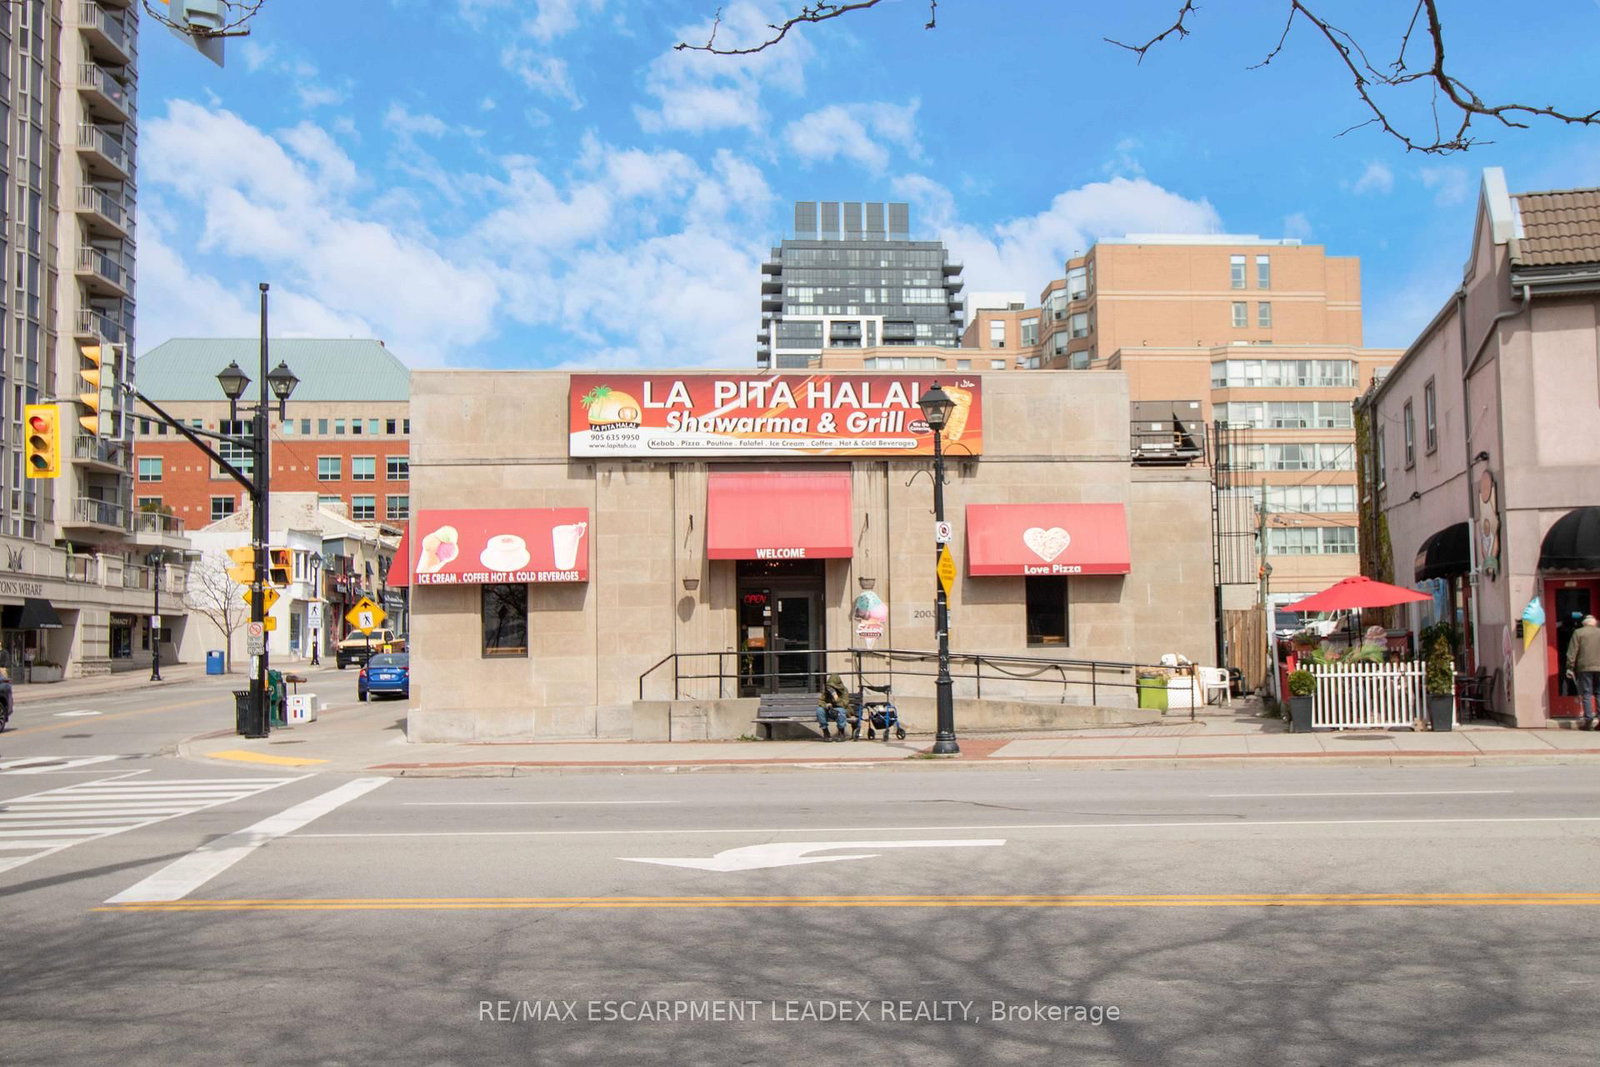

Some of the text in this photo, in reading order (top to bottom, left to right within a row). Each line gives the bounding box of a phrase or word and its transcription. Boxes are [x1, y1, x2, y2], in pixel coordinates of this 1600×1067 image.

[643, 381, 922, 409] LA PITA HALAL
[666, 410, 905, 433] Shawarma & Grill
[878, 440, 915, 448] Beverages
[756, 548, 805, 558] WELCOME
[1024, 564, 1081, 574] Love Pizza
[419, 571, 579, 584] ICE CREAM COFFEE HOT & COLD BEVERAGES
[0, 581, 17, 594] ON'S
[744, 594, 766, 604] OPEN
